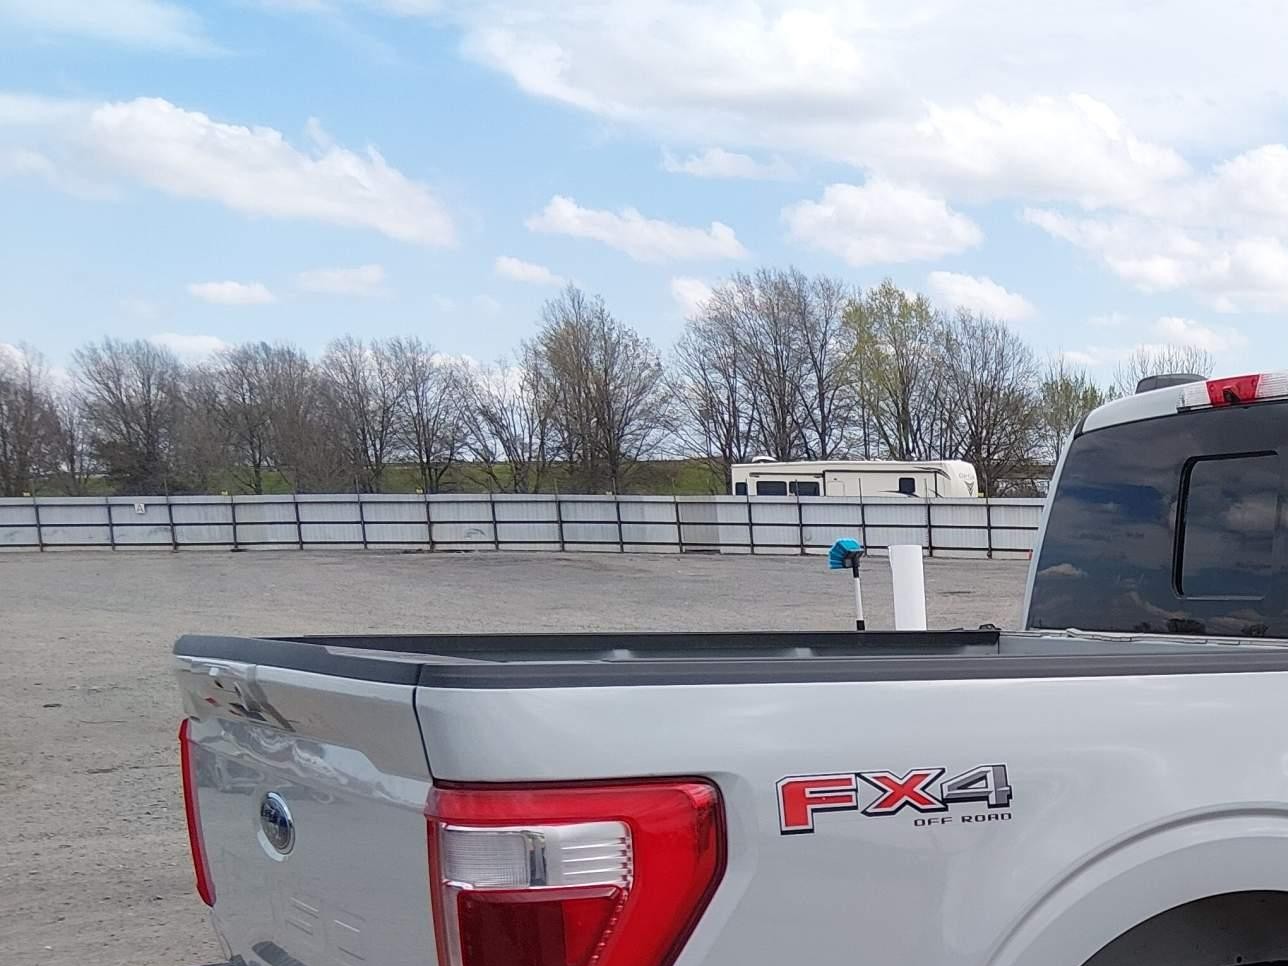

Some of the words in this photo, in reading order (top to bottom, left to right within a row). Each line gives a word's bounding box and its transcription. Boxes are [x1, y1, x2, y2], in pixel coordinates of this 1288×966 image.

[776, 764, 1013, 835] FX4
[914, 816, 953, 827] OFF
[961, 812, 1012, 823] ROAD
